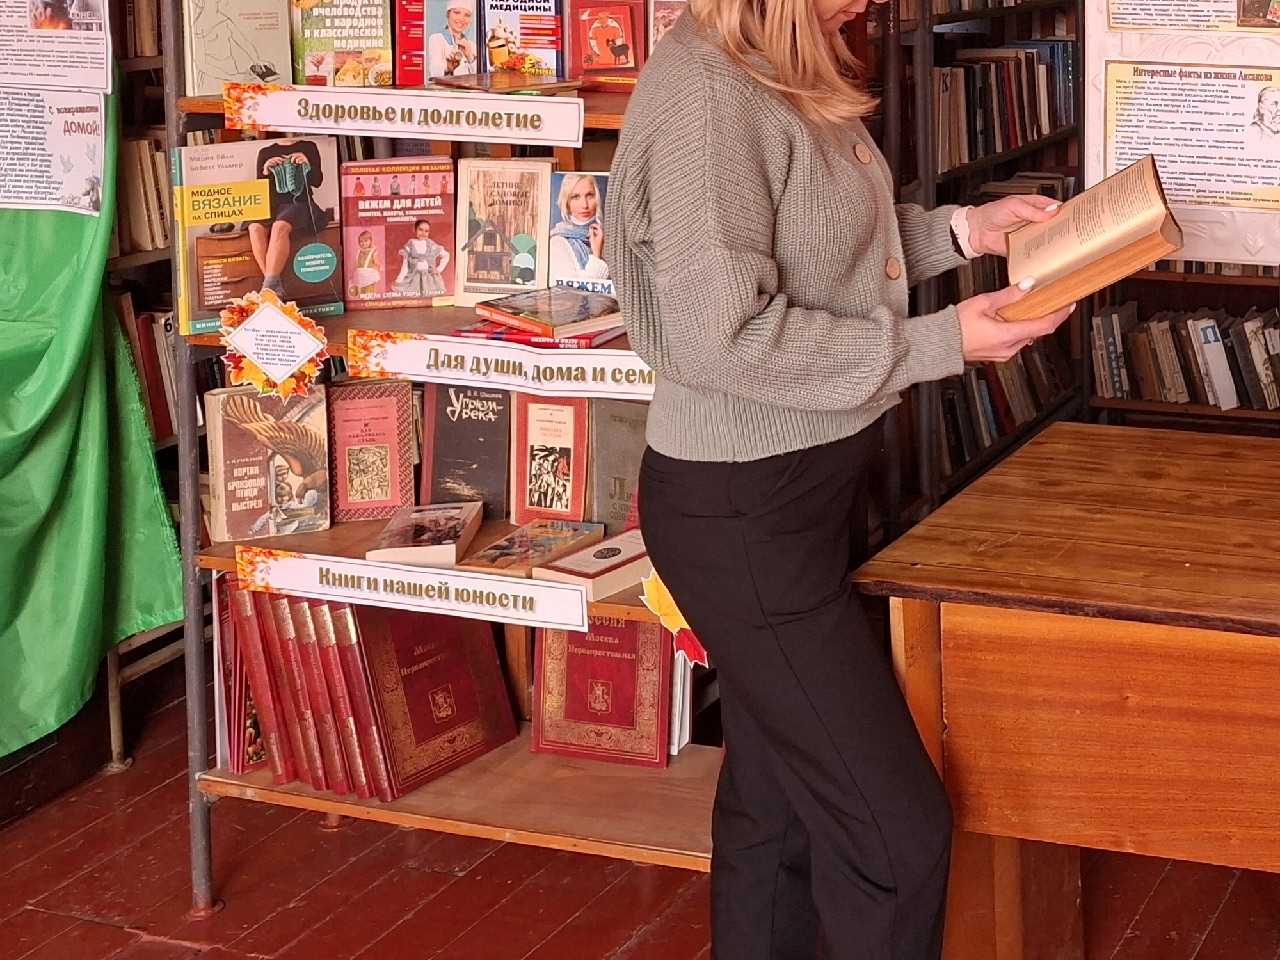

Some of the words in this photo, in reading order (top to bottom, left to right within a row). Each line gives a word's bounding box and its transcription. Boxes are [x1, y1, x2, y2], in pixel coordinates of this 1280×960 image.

[312, 6, 383, 18] пчеловодства
[489, 4, 552, 13] МЕДИЦИНЫ
[326, 19, 332, 27] в
[334, 16, 383, 28] народной
[305, 30, 311, 38] и
[313, 26, 384, 41] классической
[334, 39, 384, 51] медицине
[1132, 66, 1177, 80] Интересные
[1178, 69, 1203, 81] факты
[1213, 72, 1237, 81] жизни
[1238, 71, 1273, 82] Аксакова
[296, 96, 397, 125] Здоровье
[400, 105, 414, 124] и
[417, 107, 544, 132] долголетие
[63, 120, 100, 136] ДОМОЙ!
[217, 162, 243, 170] Ульмер
[190, 188, 232, 198] МОДНОЕ
[192, 195, 262, 211] ВЯЗАНИЕ
[358, 200, 390, 210] ВЯЖЕМ
[393, 198, 412, 209] ДЛЯ
[414, 196, 442, 209] ДЕТЕЙ
[204, 209, 243, 220] СПИЦАХ
[1201, 325, 1221, 345] П
[425, 347, 465, 371] Для
[469, 351, 529, 378] души,
[531, 355, 587, 384] дома
[591, 361, 606, 381] и
[611, 363, 655, 385] сем
[447, 388, 504, 422] Угрюм-
[462, 409, 498, 422] река
[233, 467, 260, 476] КОРТИК
[227, 478, 265, 491] БРОНЗОВАЯ
[235, 488, 258, 497] ПТИЦА
[231, 499, 263, 512] ВЫСТРЕЛ
[317, 566, 379, 593] Книги
[382, 576, 451, 601] нашей
[453, 584, 536, 614] юности
[588, 616, 626, 628] оссия
[586, 632, 619, 644] Москва
[568, 647, 636, 660] Первопрестольная
